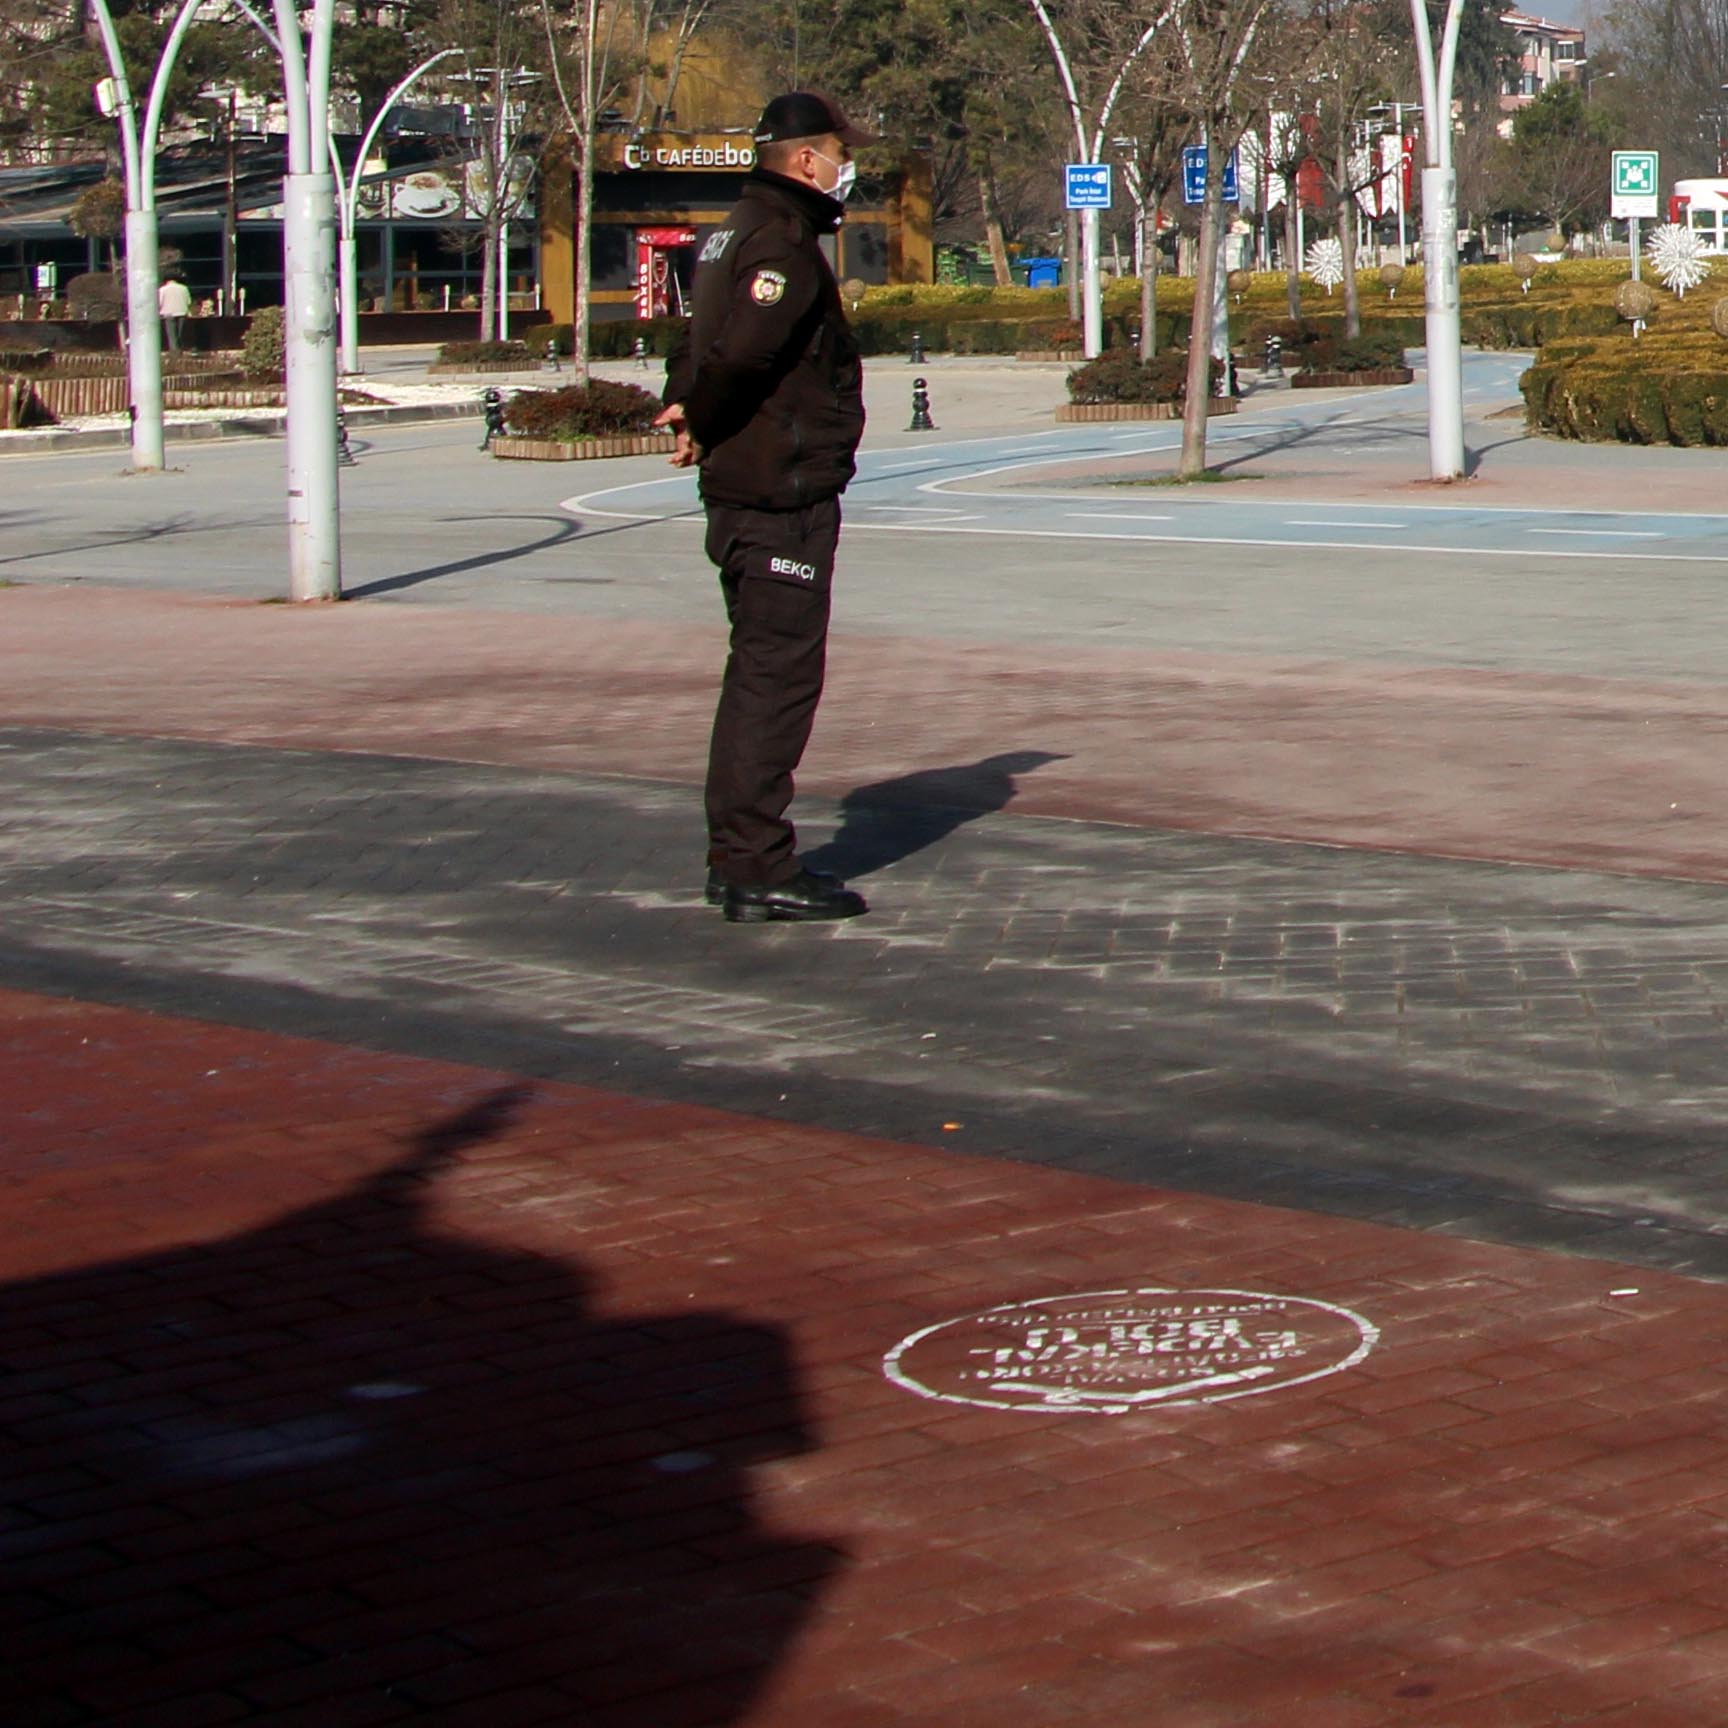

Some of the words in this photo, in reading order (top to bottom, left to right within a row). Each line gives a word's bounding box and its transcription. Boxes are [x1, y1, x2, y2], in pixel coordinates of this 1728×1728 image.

[656, 141, 757, 167] CAFÉDEbo
[1070, 173, 1091, 183] EDS
[1024, 1318, 1242, 1349] BOLU
[1110, 1330, 1298, 1359] EVDE
[968, 1342, 1107, 1364] KAL
